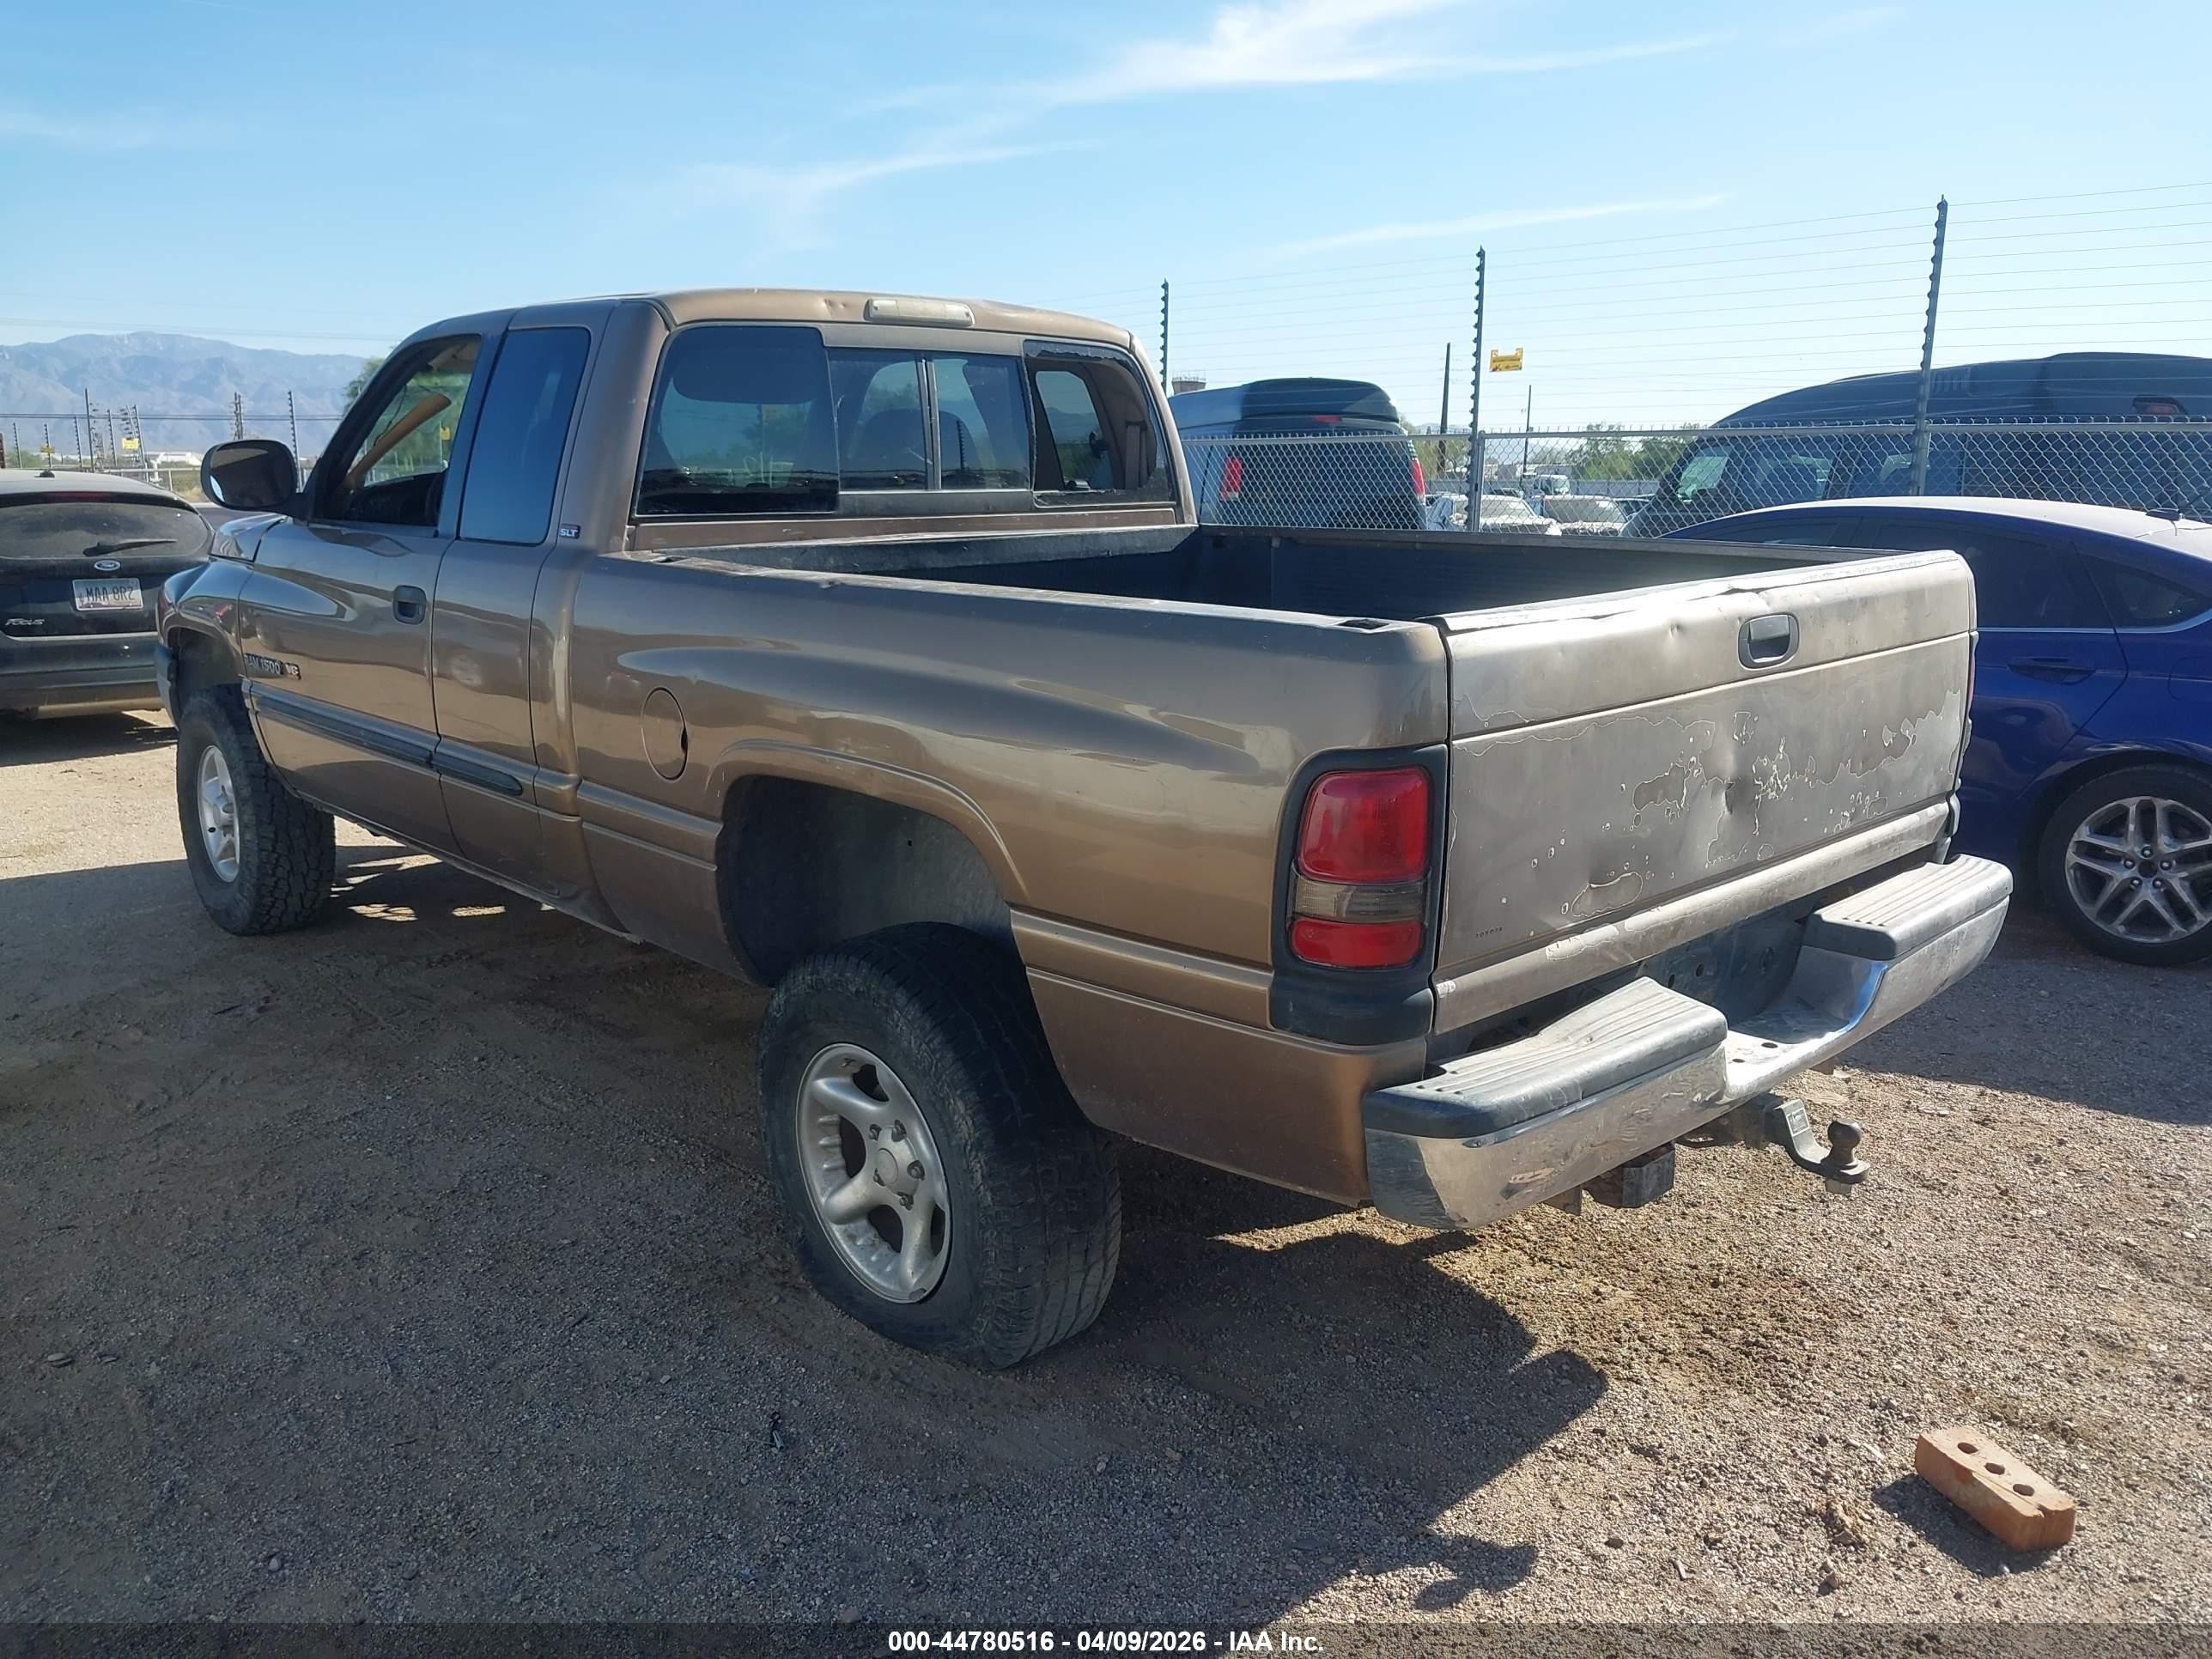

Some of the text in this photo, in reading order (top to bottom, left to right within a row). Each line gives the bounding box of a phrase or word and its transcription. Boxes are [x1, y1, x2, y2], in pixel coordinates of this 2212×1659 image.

[560, 528, 579, 537] SLT
[86, 586, 109, 602] MAA
[261, 658, 281, 675] 1500
